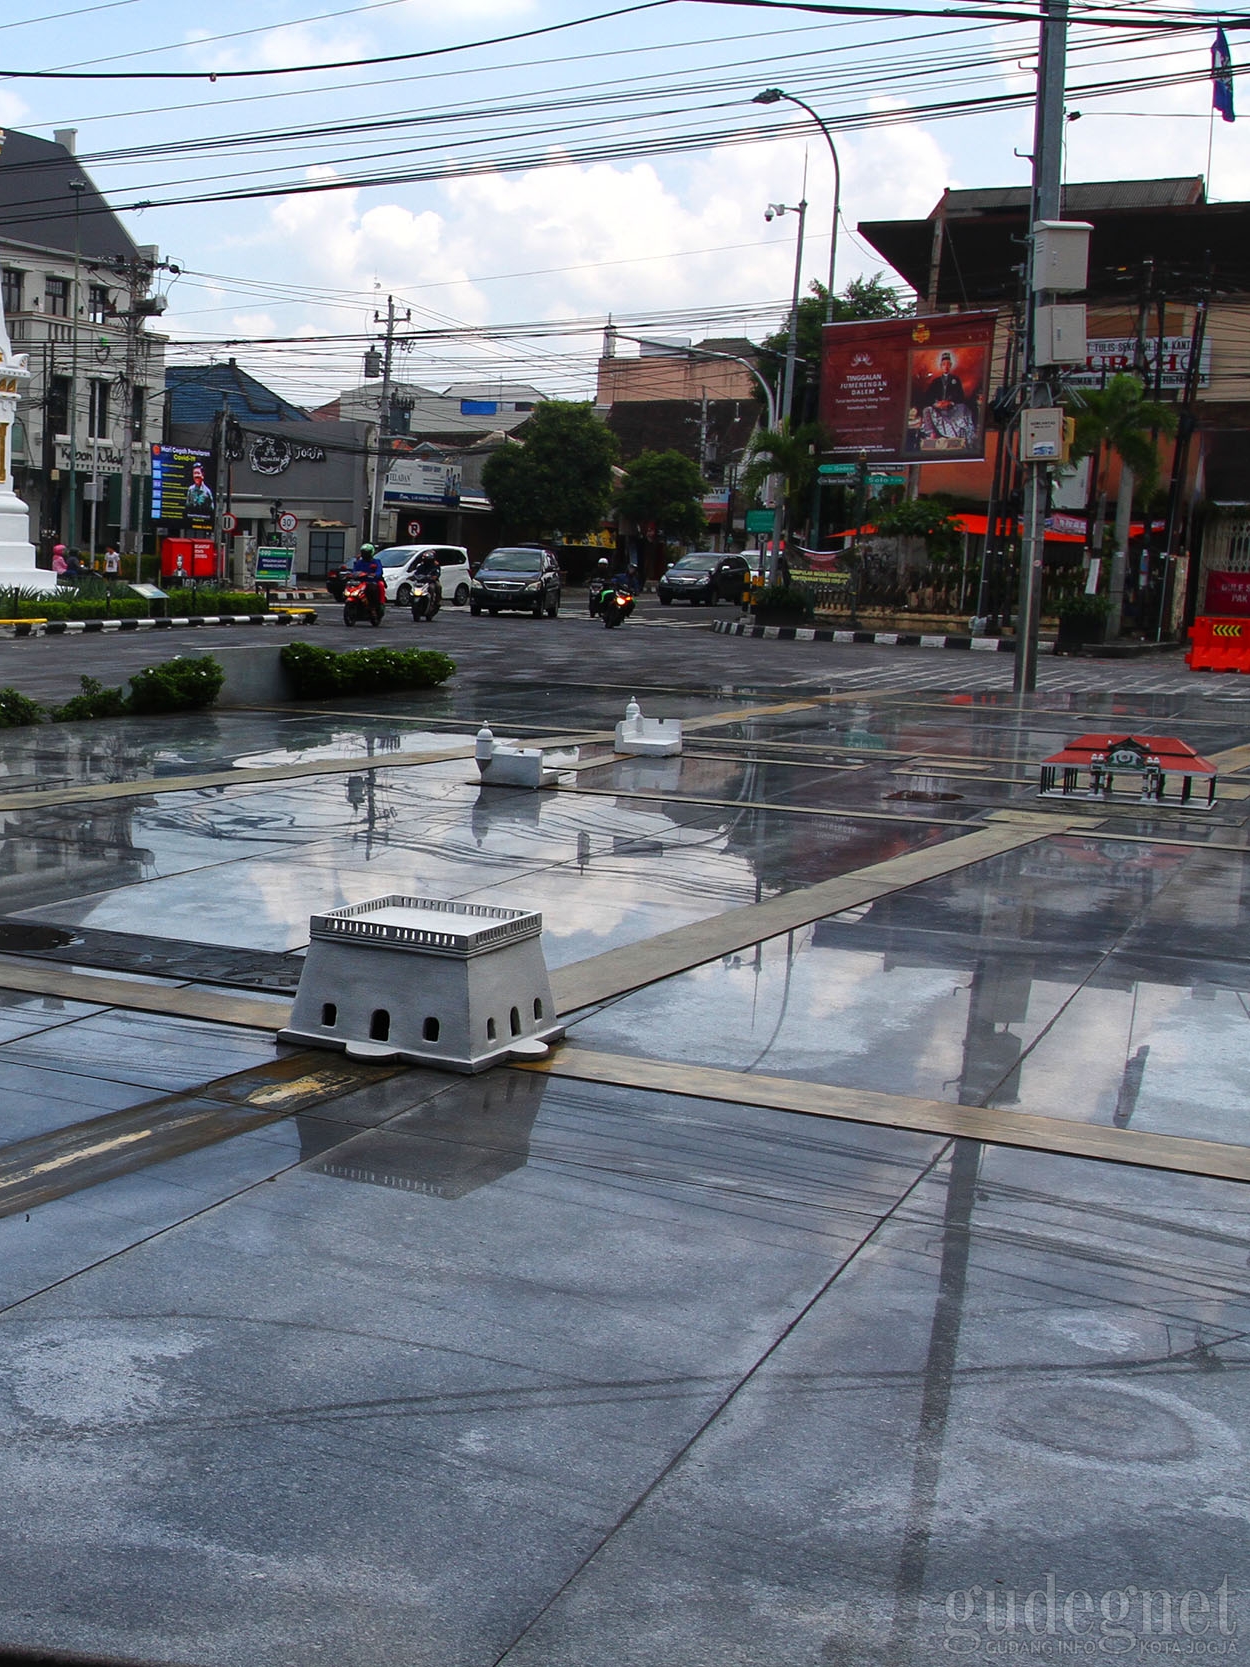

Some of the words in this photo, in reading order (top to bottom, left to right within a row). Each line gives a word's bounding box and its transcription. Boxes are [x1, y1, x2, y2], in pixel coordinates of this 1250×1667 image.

[1094, 341, 1116, 353] TULIS
[846, 374, 882, 382] TINGGALAN
[840, 381, 887, 389] JUMENENGAN
